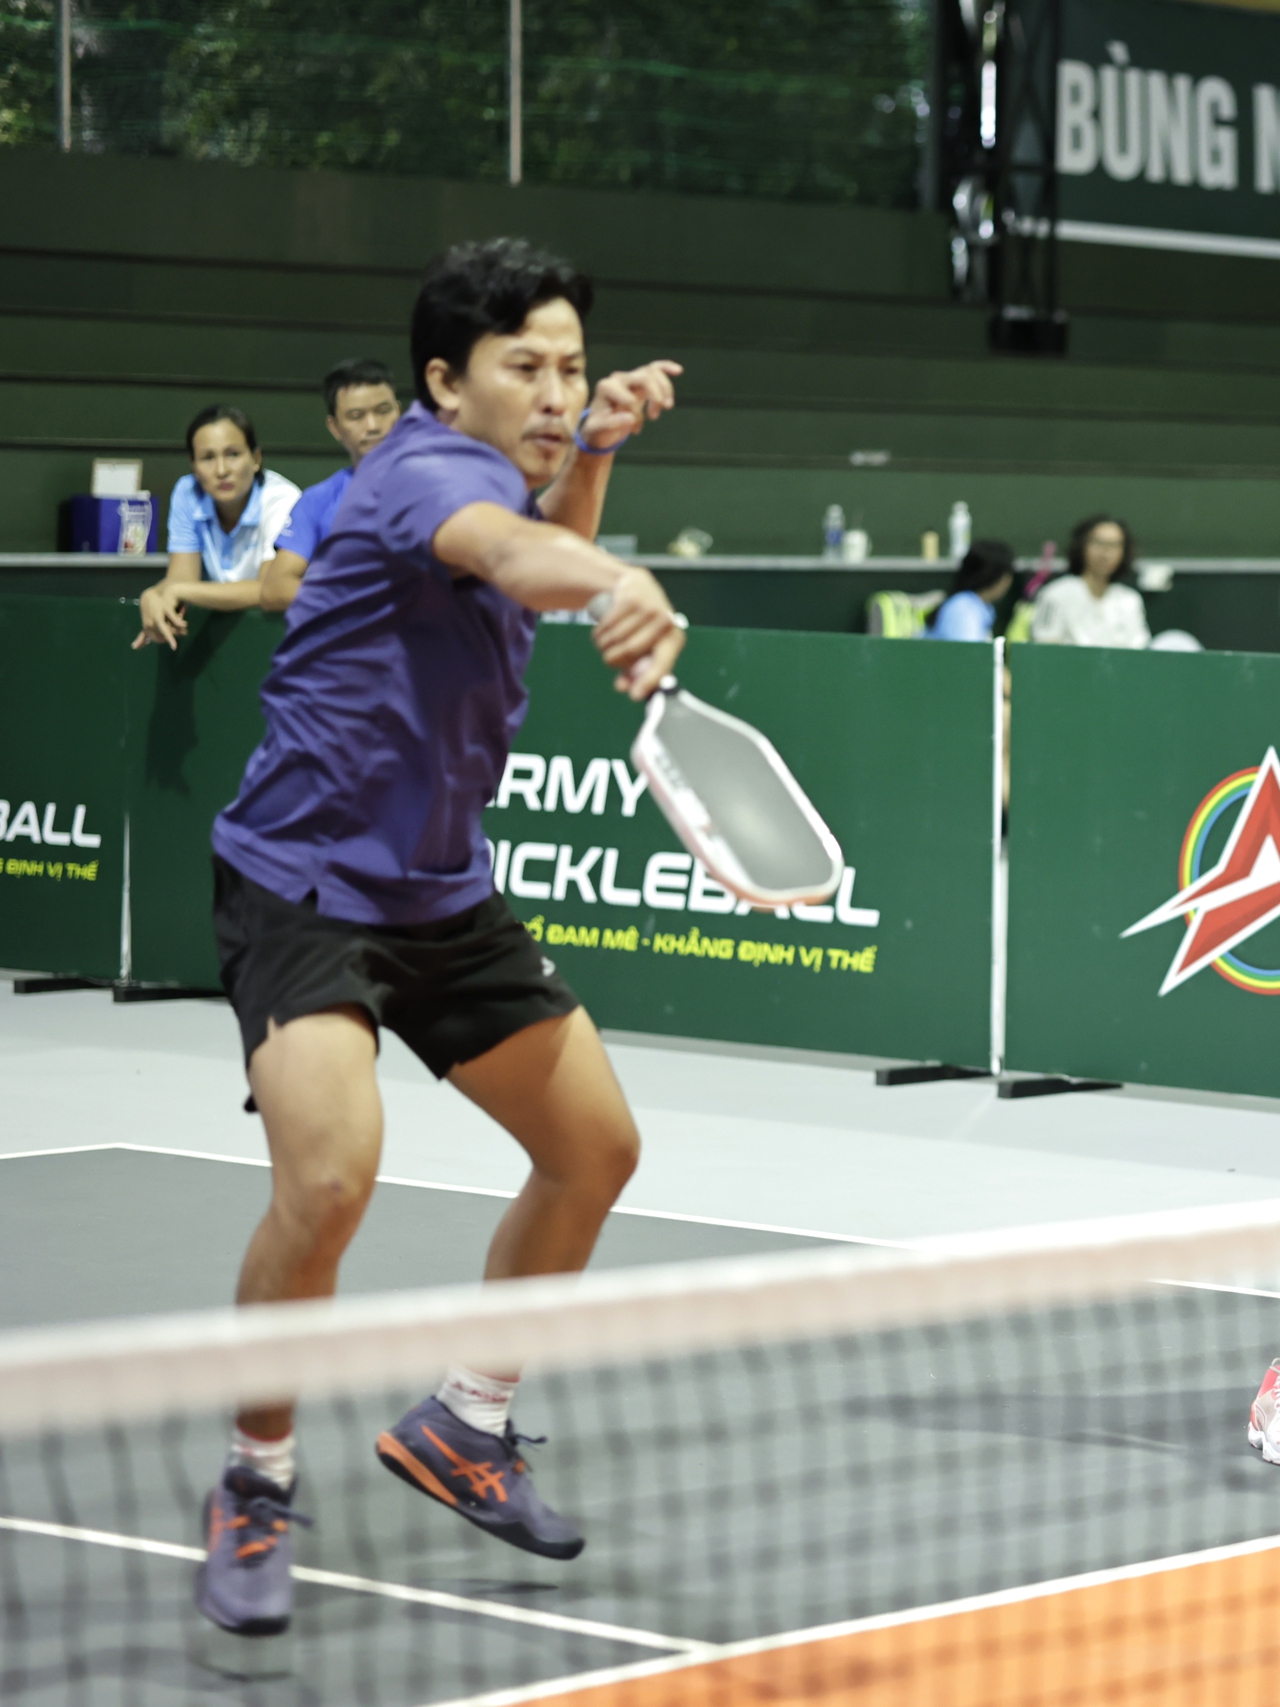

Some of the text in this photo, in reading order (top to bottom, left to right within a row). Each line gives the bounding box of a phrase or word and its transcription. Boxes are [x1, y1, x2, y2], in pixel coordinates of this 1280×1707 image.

[1056, 40, 1238, 191] BÙNG
[485, 752, 649, 818] RMY
[545, 923, 600, 948] ĐAM
[602, 925, 640, 952] MÊ
[737, 939, 795, 968] ĐỊNH
[799, 944, 823, 973] VỊ
[827, 944, 878, 973] THẾ
